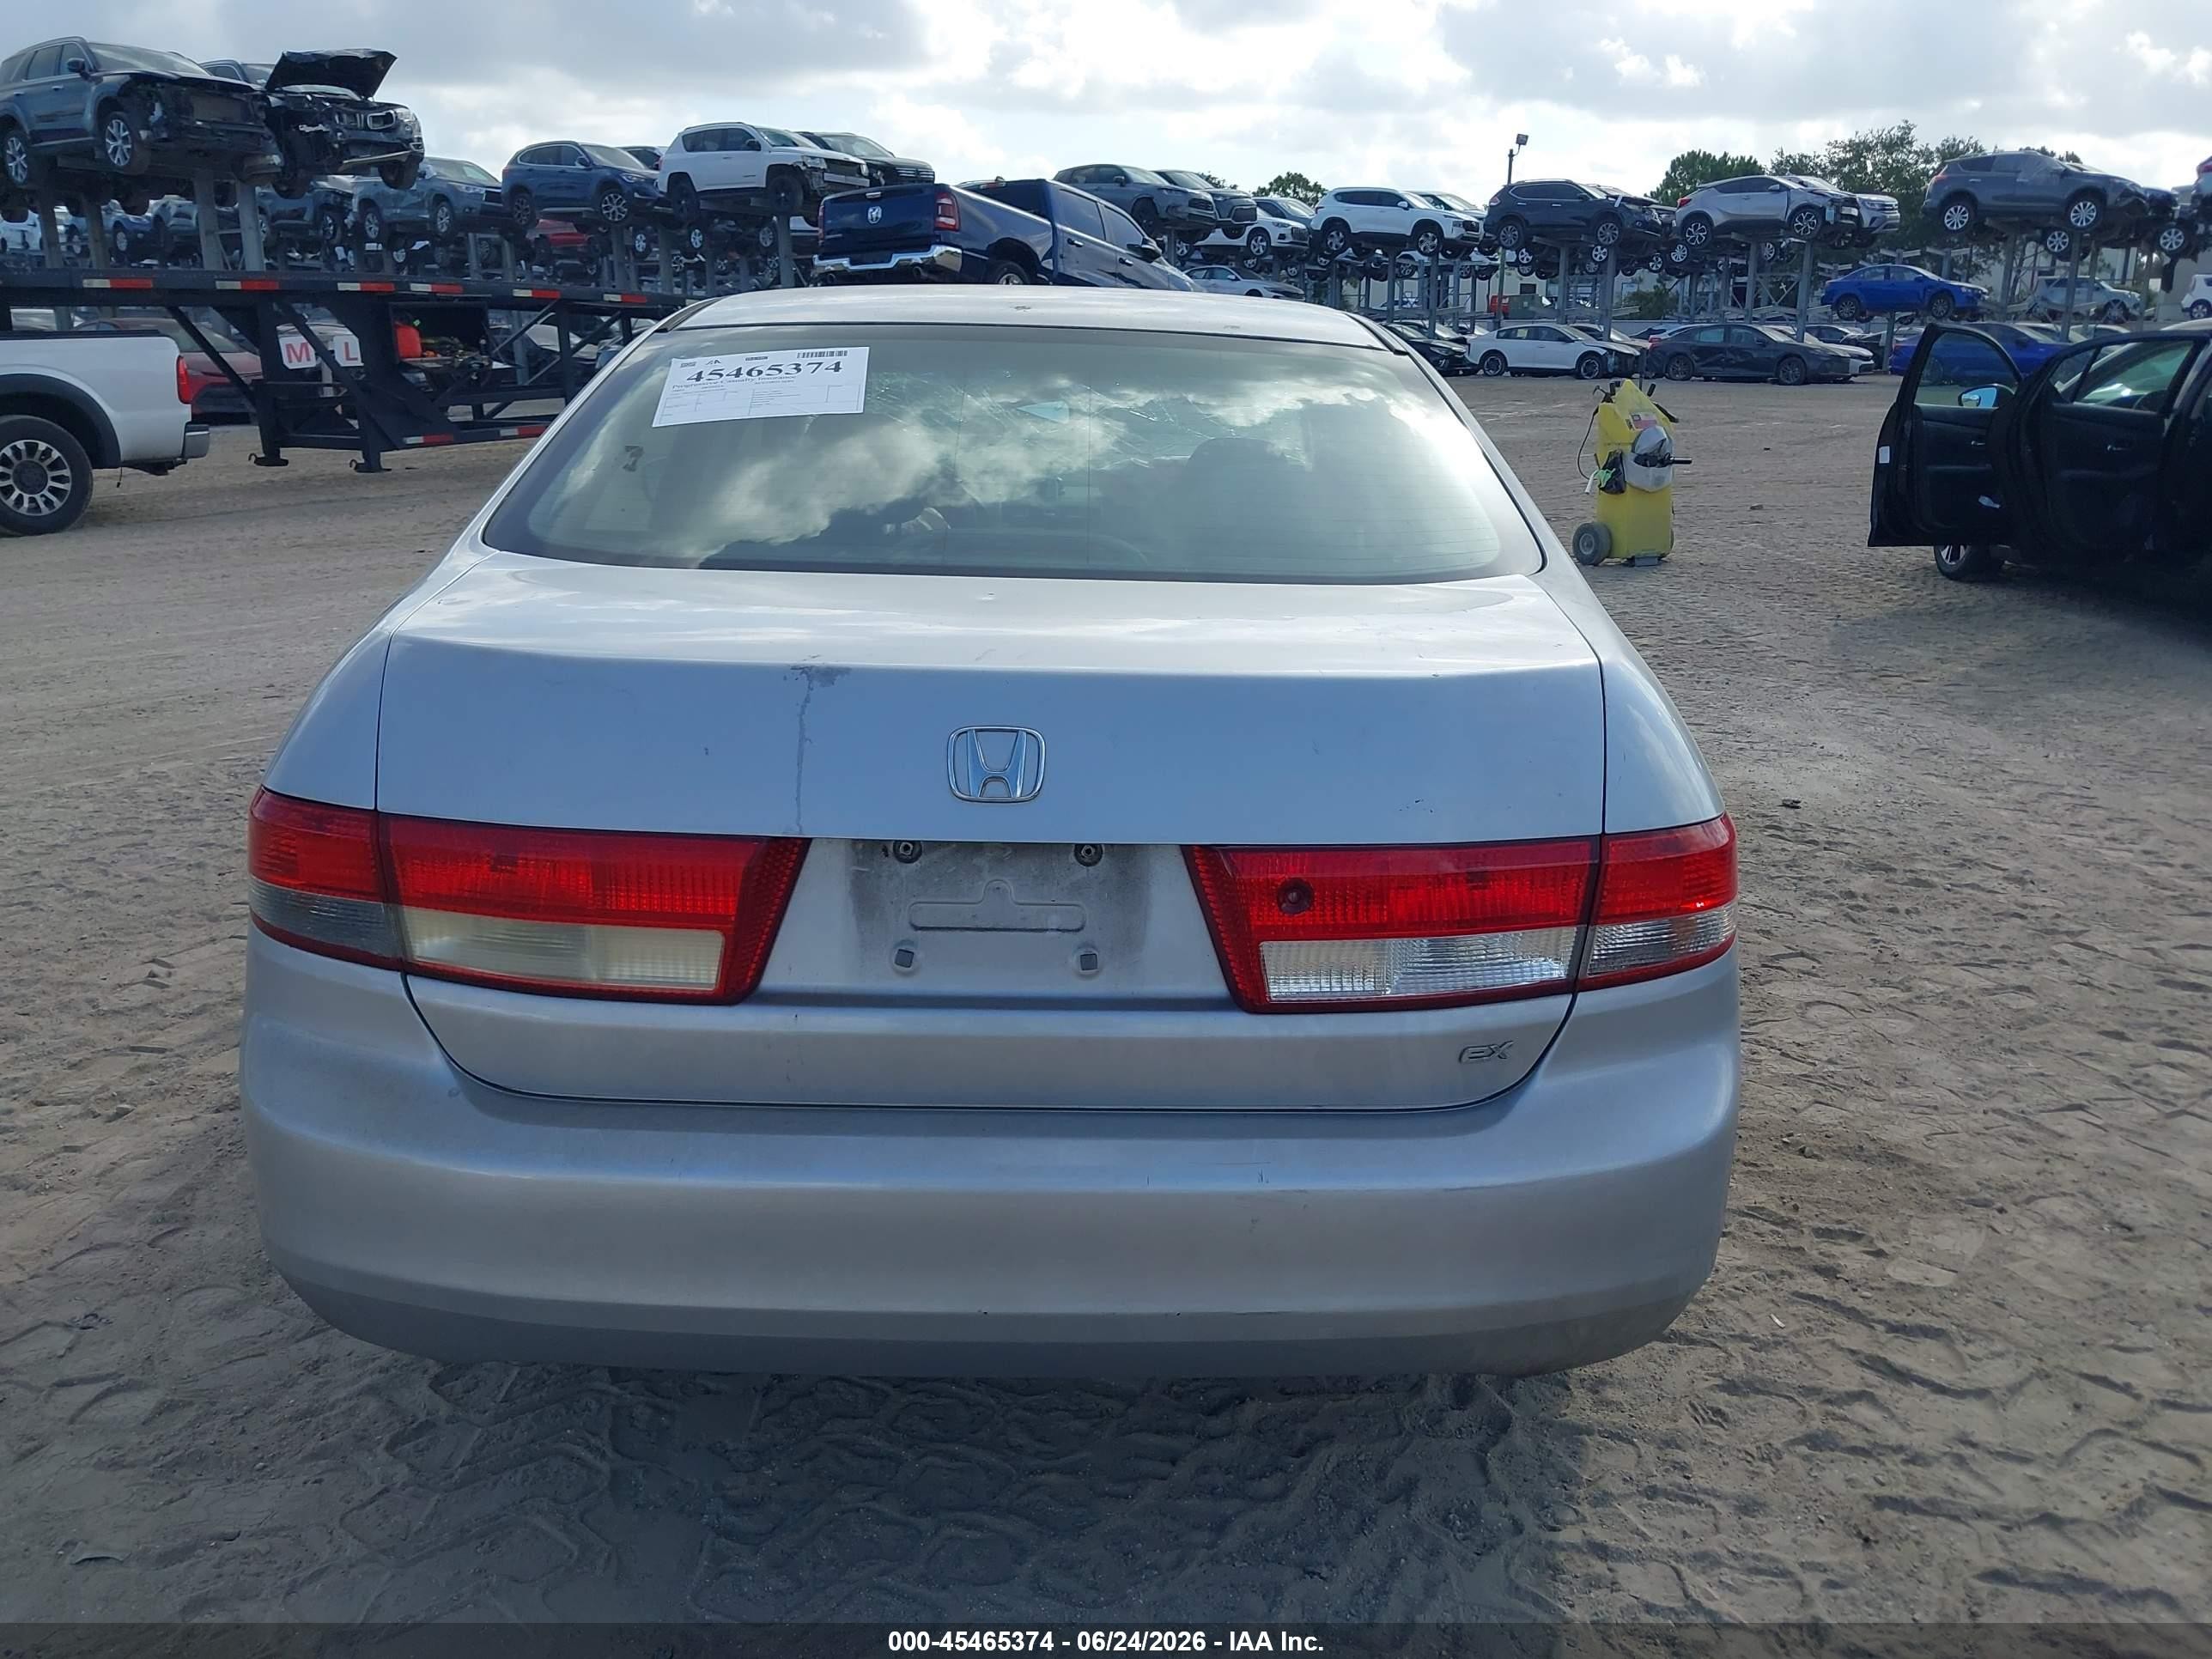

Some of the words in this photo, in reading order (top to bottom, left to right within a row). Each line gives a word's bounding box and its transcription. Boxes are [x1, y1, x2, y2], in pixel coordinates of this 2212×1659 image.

[285, 342, 311, 363] M
[344, 341, 359, 361] L
[686, 360, 843, 383] 45465374
[1459, 1040, 1515, 1063] EX
